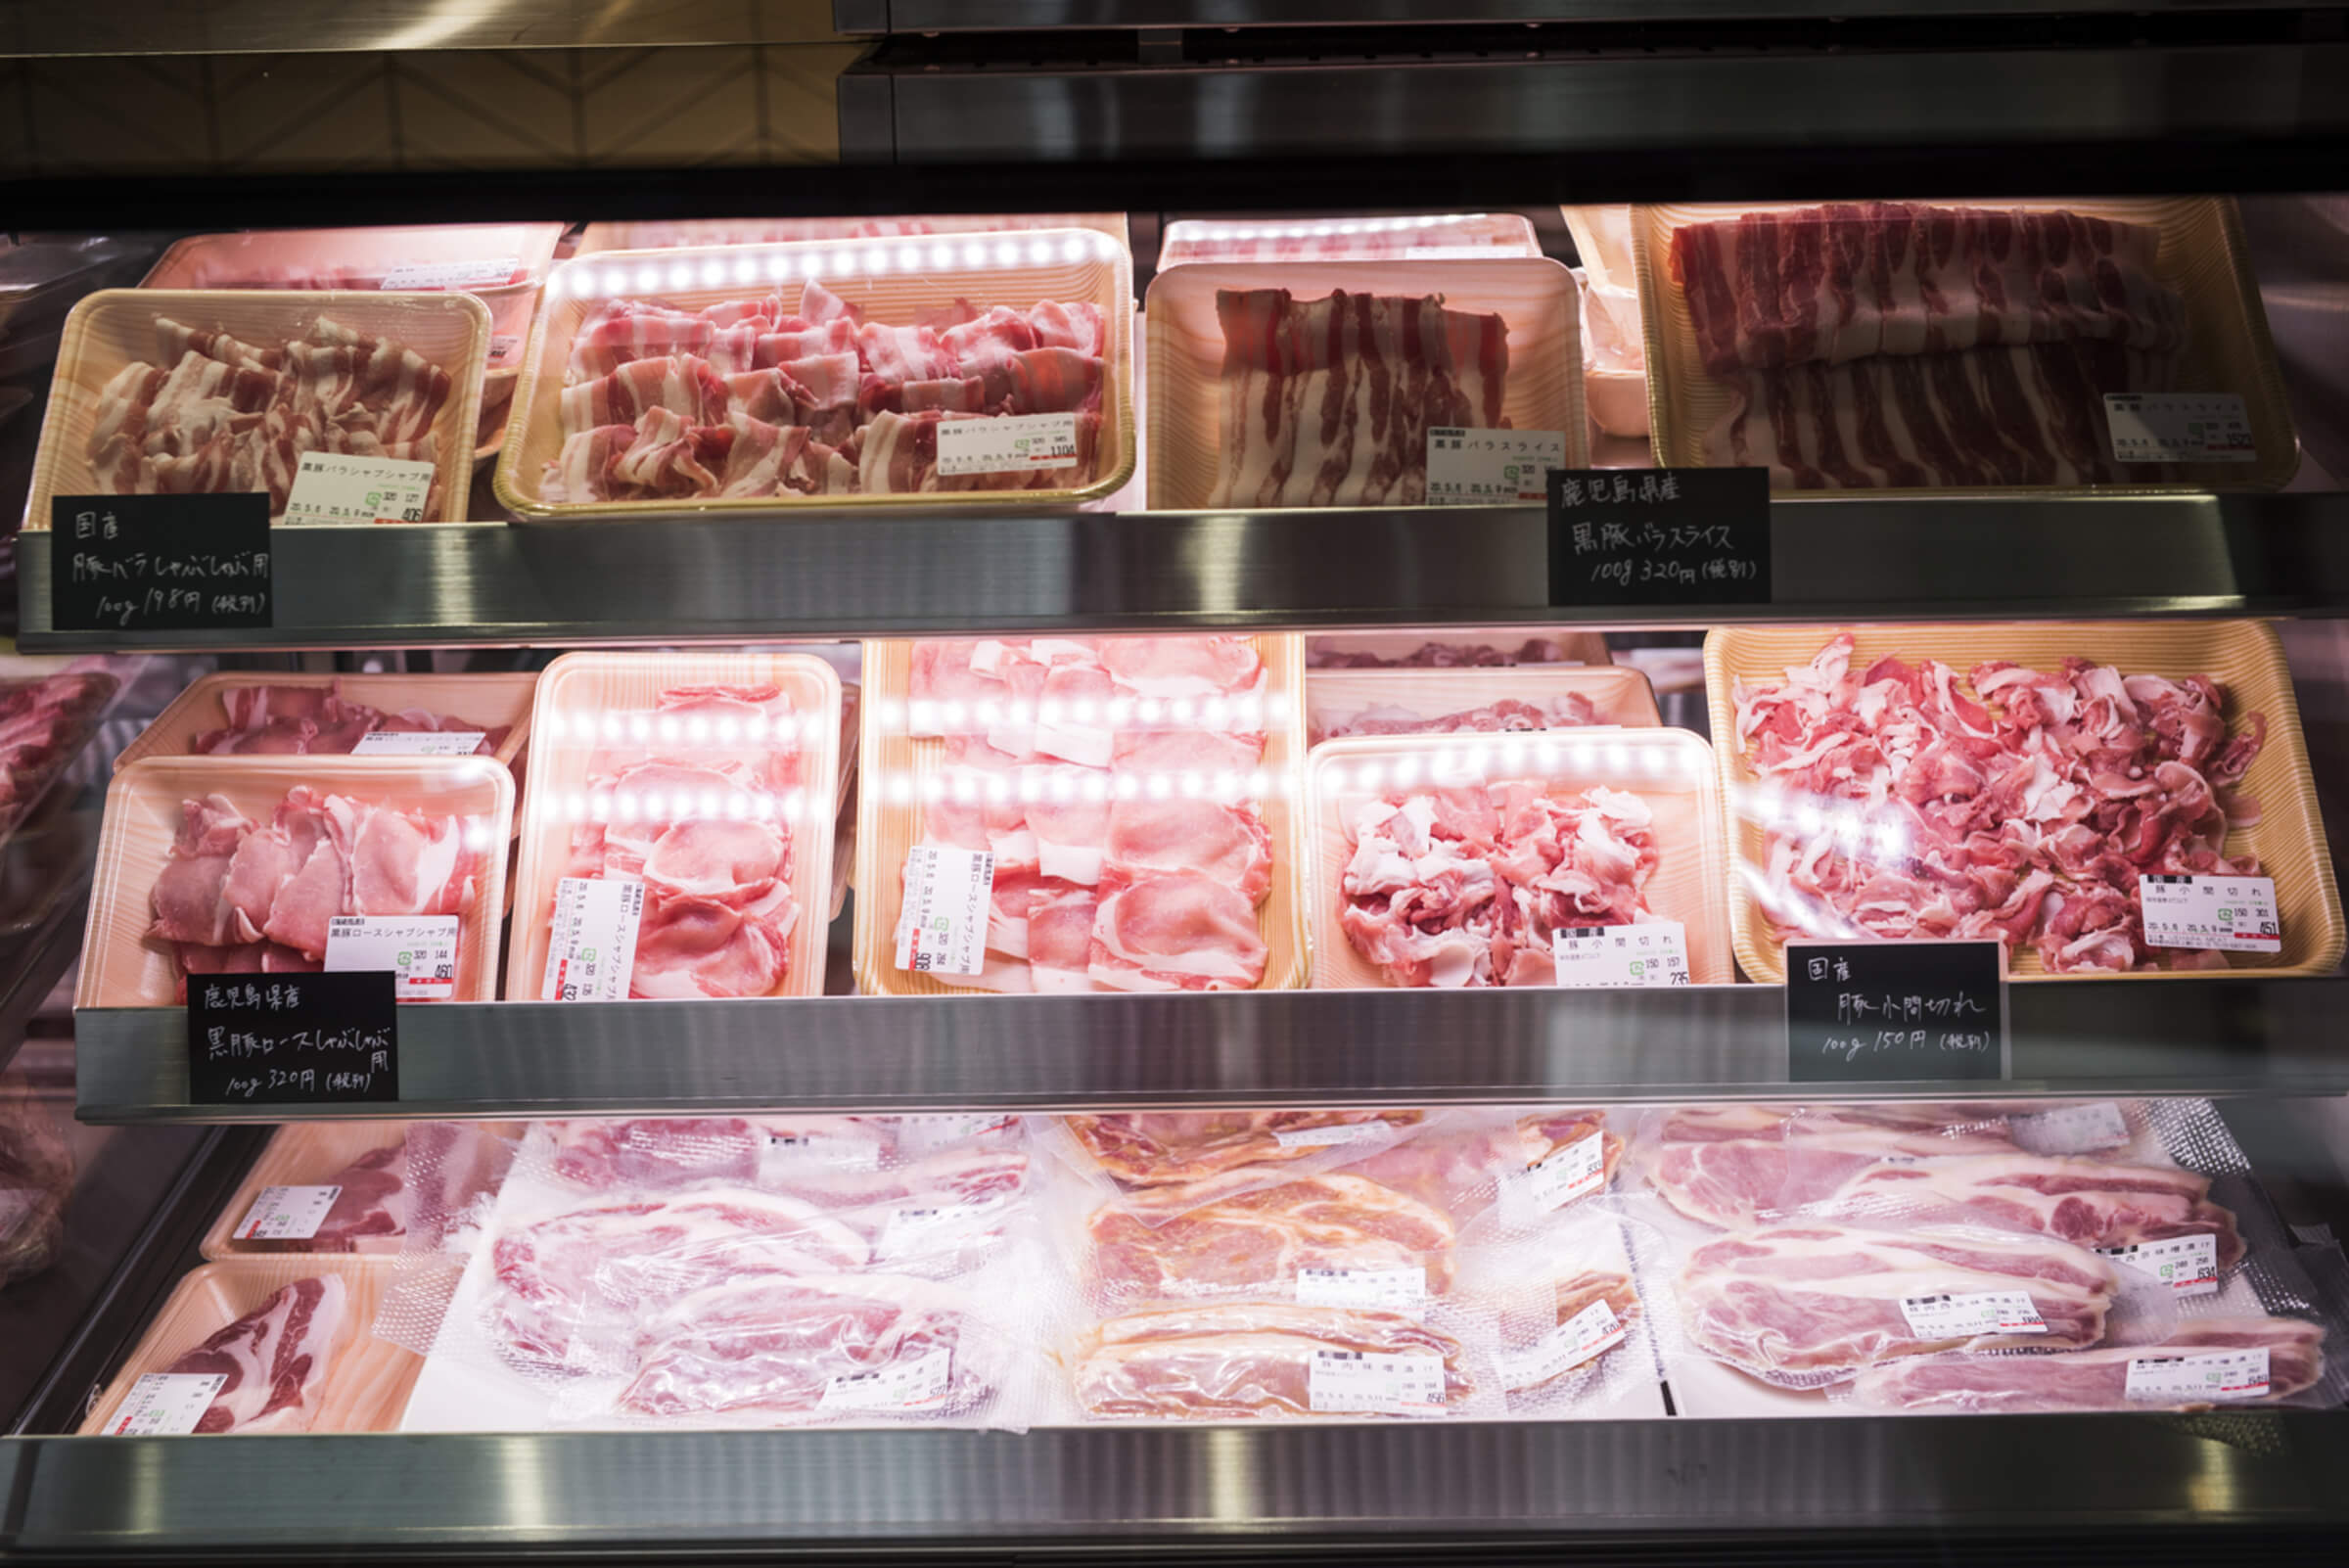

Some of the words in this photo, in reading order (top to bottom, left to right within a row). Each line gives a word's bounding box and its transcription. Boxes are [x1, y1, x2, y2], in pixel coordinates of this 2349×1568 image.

[1561, 471, 1681, 509] 鹿児島県産
[75, 511, 118, 539] 国産
[1572, 522, 1734, 556] 黒豚バラスライス
[1590, 559, 1633, 586] 100g
[1639, 559, 1696, 584] 320円
[96, 596, 139, 626] 100g
[143, 587, 201, 616] 198円
[2155, 885, 2261, 897] 豚小間切れ
[1568, 936, 1673, 949] 豚小間切れ
[1808, 956, 1852, 983] 国産
[204, 984, 301, 1010] 鹿児島県産
[1837, 991, 1987, 1026] 豚小間切れ
[1821, 1038, 1867, 1062] 100g
[1872, 1030, 1927, 1052] 150円
[225, 1079, 263, 1098] 100g
[267, 1069, 315, 1092] 320円
